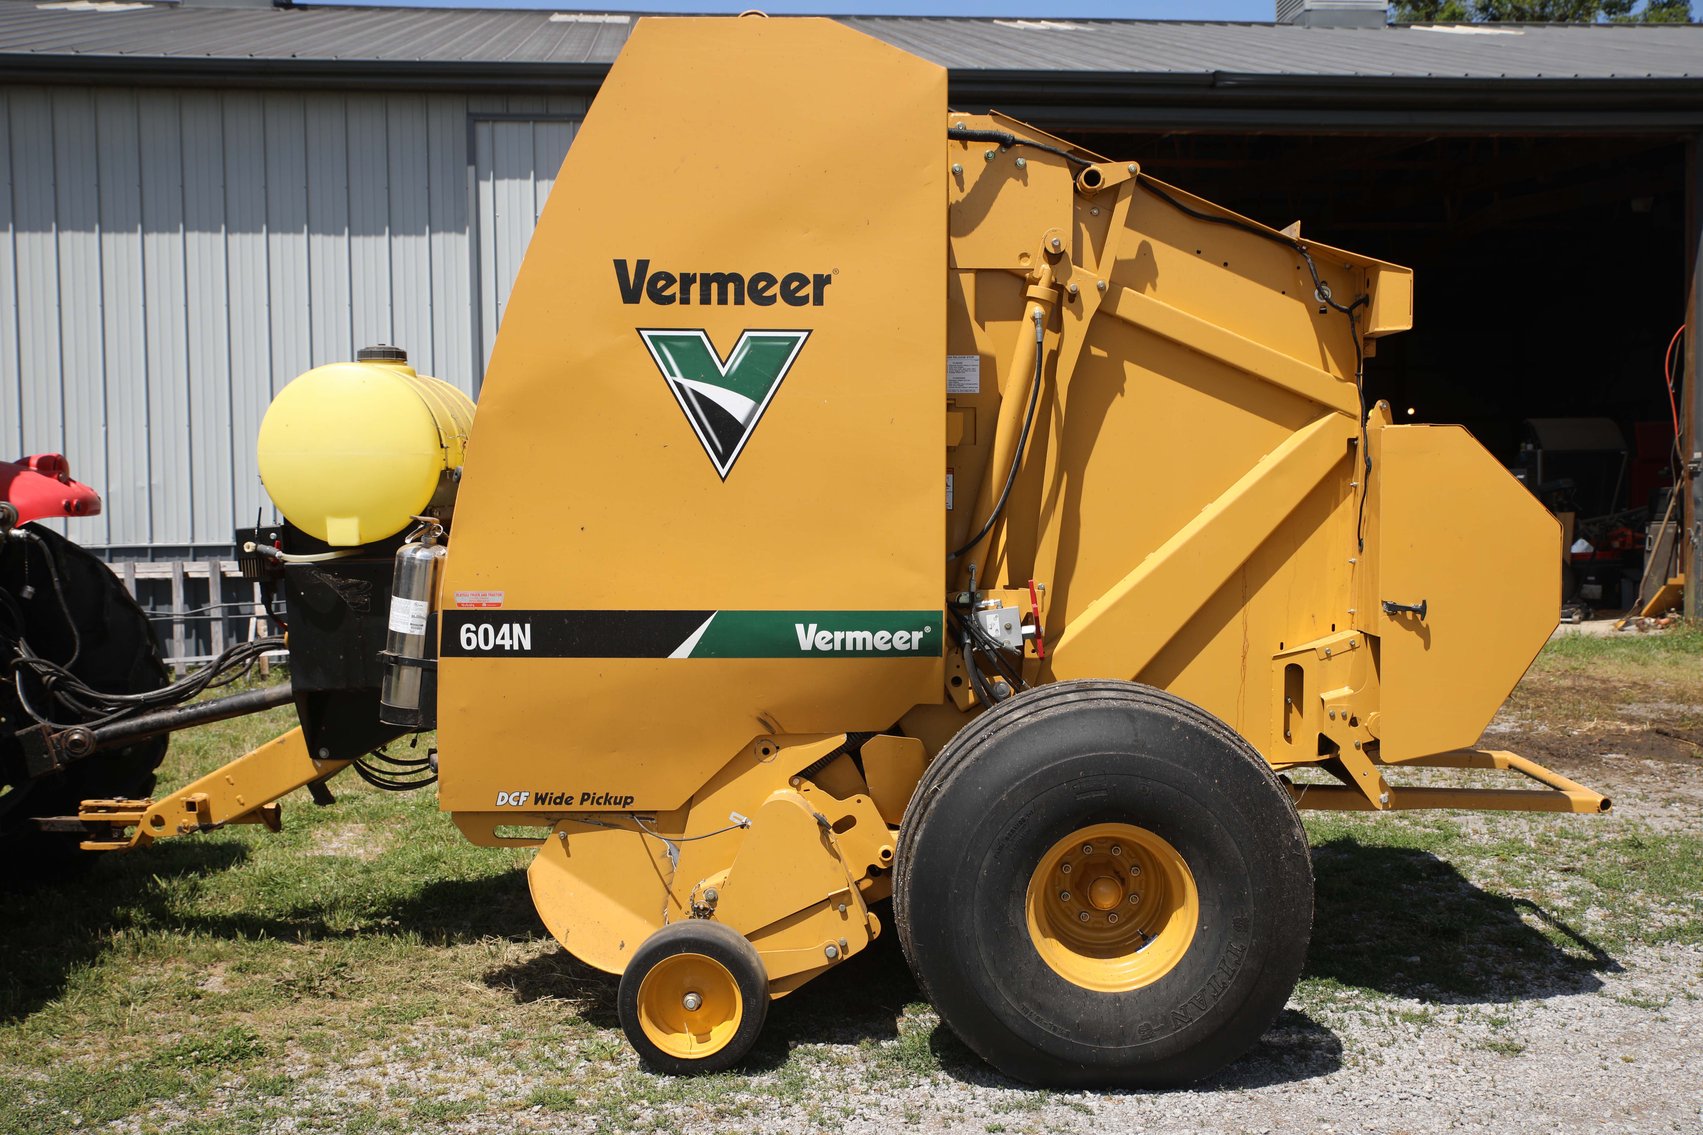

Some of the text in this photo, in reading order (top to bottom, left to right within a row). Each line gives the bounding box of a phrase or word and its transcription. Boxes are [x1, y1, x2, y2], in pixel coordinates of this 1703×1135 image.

[460, 623, 532, 651] 604N
[496, 791, 635, 808] DCF Wide Pickup
